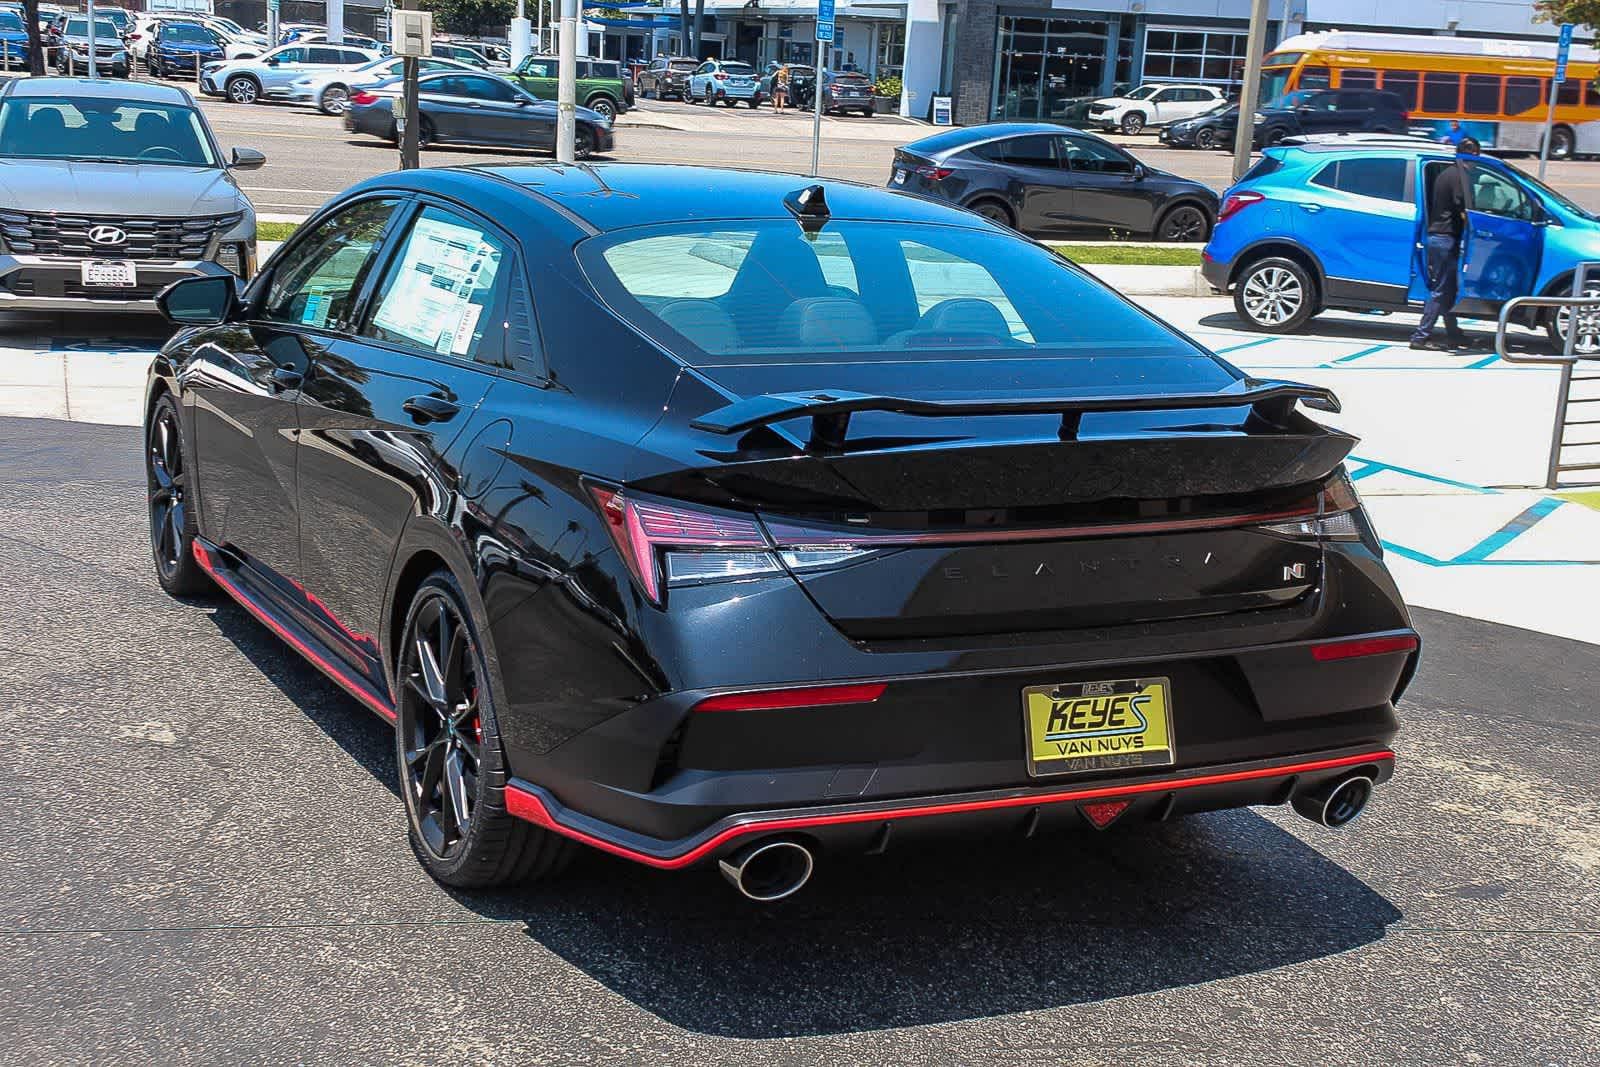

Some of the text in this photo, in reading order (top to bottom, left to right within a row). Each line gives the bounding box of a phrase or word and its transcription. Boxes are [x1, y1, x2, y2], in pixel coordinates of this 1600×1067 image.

[1046, 695, 1152, 739] KEYES
[1056, 736, 1144, 755] VAN NUYS
[1065, 754, 1143, 770] VAN NUYS
